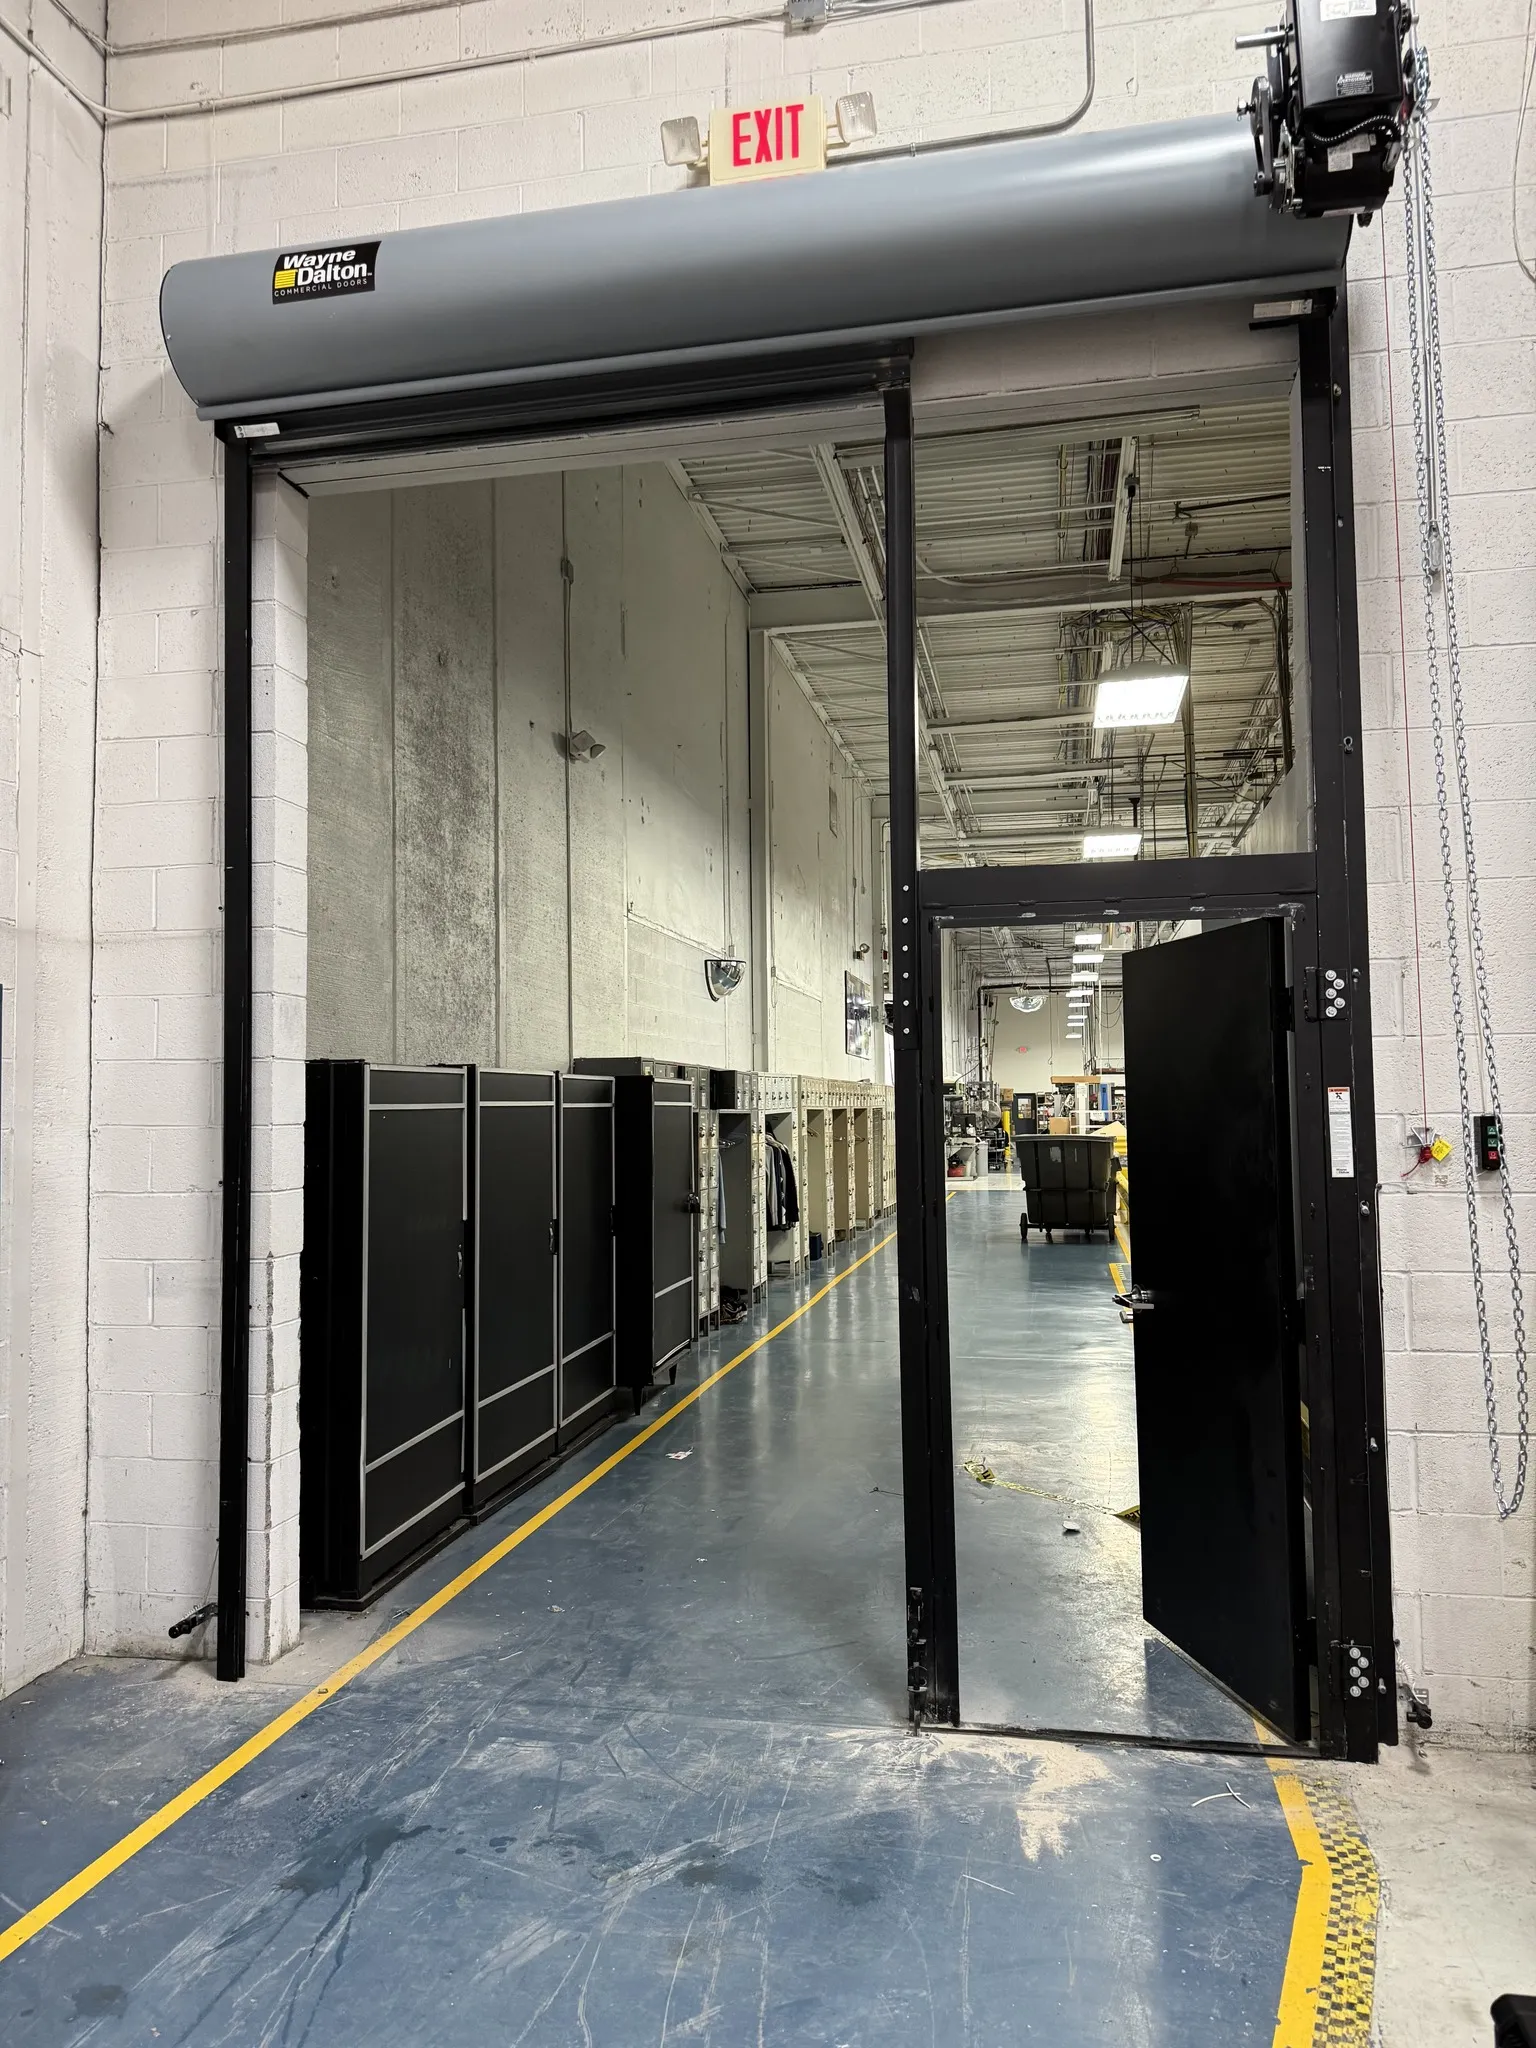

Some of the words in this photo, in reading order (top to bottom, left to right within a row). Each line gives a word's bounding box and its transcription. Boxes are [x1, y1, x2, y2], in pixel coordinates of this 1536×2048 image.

[733, 104, 804, 167] EXIT
[284, 250, 356, 270] Wayne
[297, 263, 368, 286] Dalton
[274, 284, 332, 297] COMMERCIAL
[336, 278, 368, 288] DOORS
